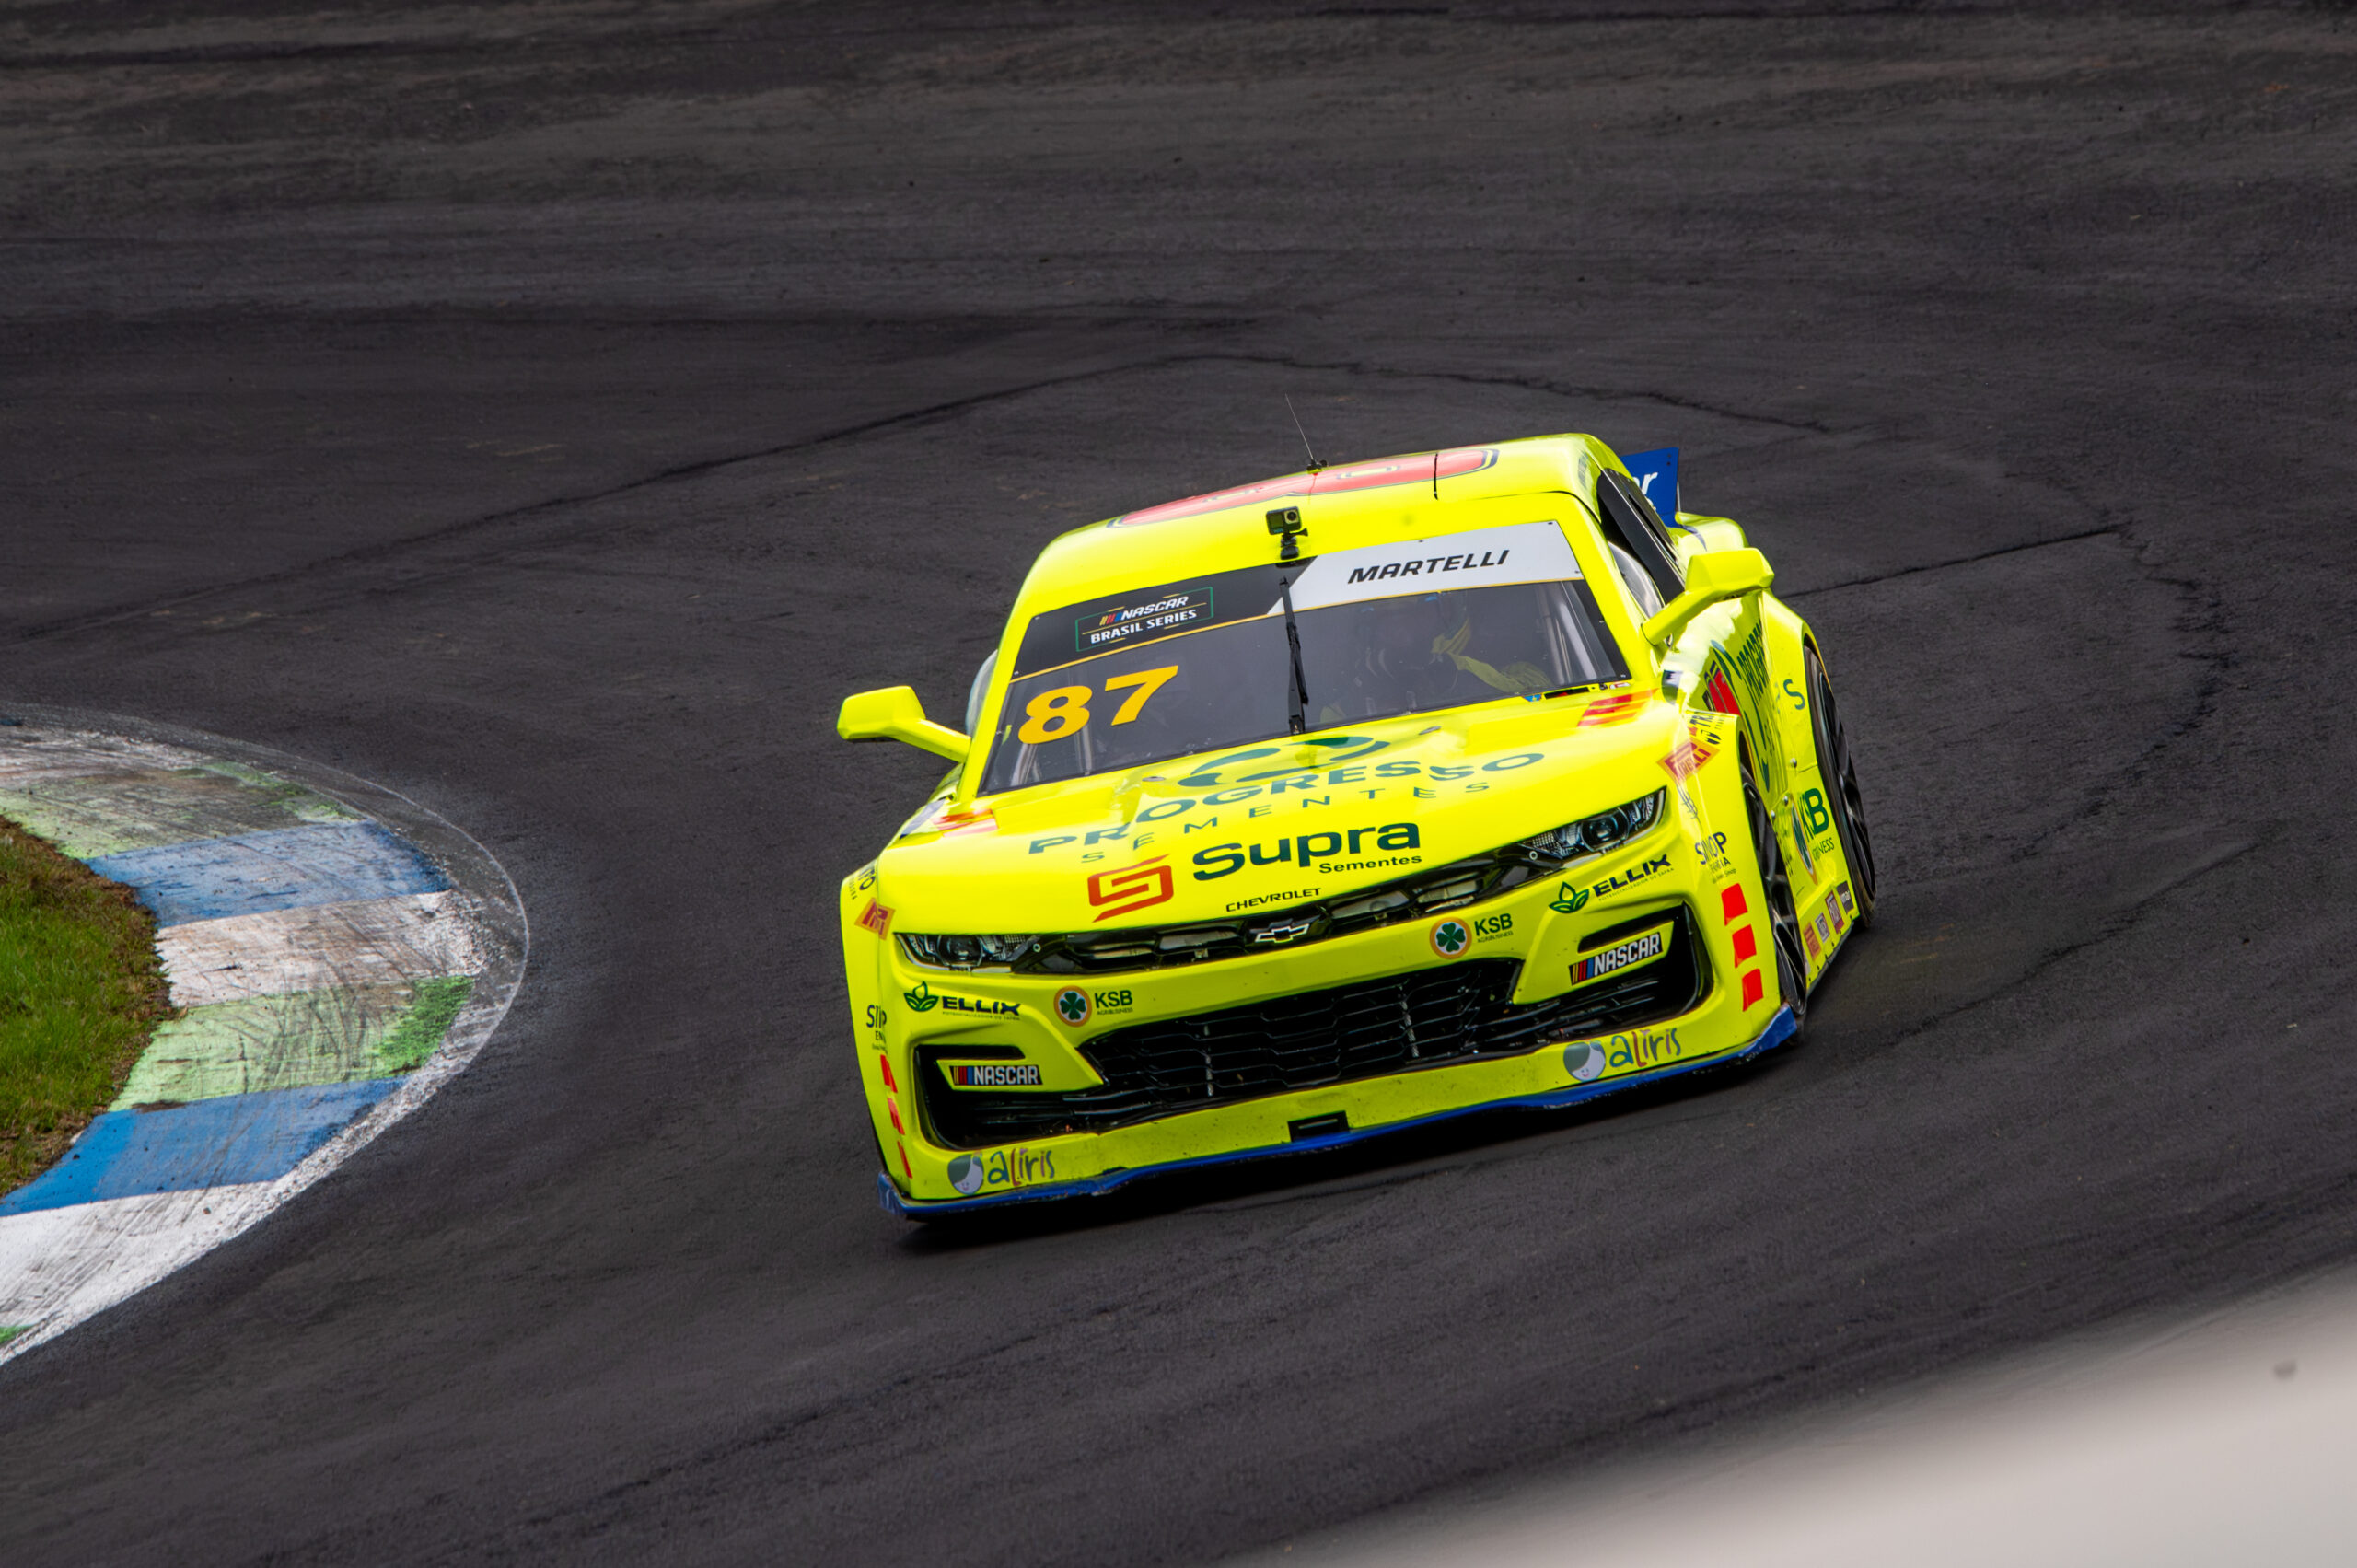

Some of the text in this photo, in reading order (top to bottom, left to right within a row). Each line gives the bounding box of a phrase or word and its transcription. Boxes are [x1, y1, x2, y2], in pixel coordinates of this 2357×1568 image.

[1347, 550, 1510, 585] MARTELLI
[1120, 595, 1190, 622] NASCAR
[1089, 608, 1198, 645] BRASIL SERIES
[1017, 664, 1179, 745] 87
[1028, 752, 1545, 855] PROGRESSO
[1080, 781, 1492, 864] SEMENTES
[1191, 822, 1422, 881] Supra
[1318, 853, 1423, 876] Sementes
[1592, 853, 1673, 899] ELLIX
[1225, 887, 1322, 912] CHEVROLET
[1474, 913, 1514, 937] KSB
[1593, 932, 1661, 977] NASCAR
[942, 995, 1021, 1016] ELLIX
[1094, 989, 1133, 1009] KSB
[973, 1065, 1040, 1086] NASCAR
